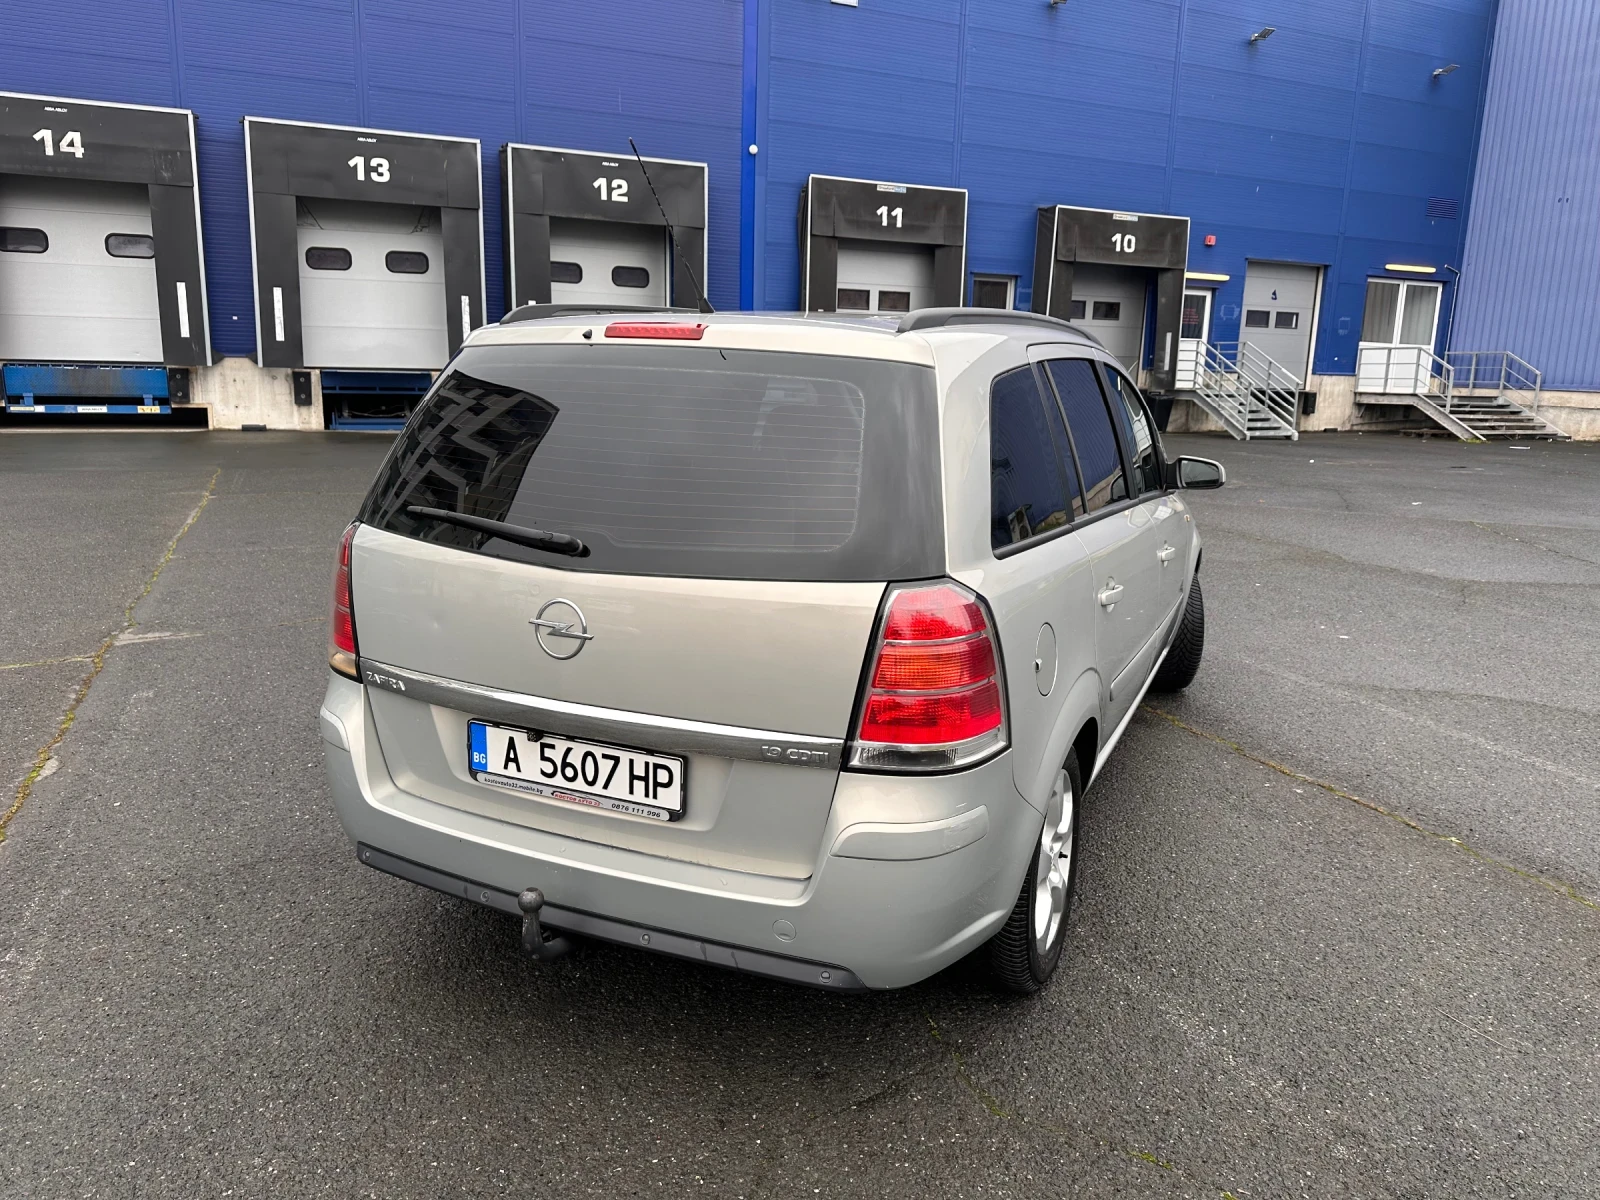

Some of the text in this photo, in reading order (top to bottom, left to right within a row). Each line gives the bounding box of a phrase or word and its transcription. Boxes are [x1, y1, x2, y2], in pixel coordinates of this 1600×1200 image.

[32, 128, 85, 158] 14
[347, 155, 391, 183] 13
[592, 177, 629, 203] 12
[876, 205, 903, 228] 11
[1111, 233, 1136, 253] 10
[473, 752, 486, 764] BG
[503, 736, 674, 800] A 5607 HP
[632, 807, 645, 815] 111
